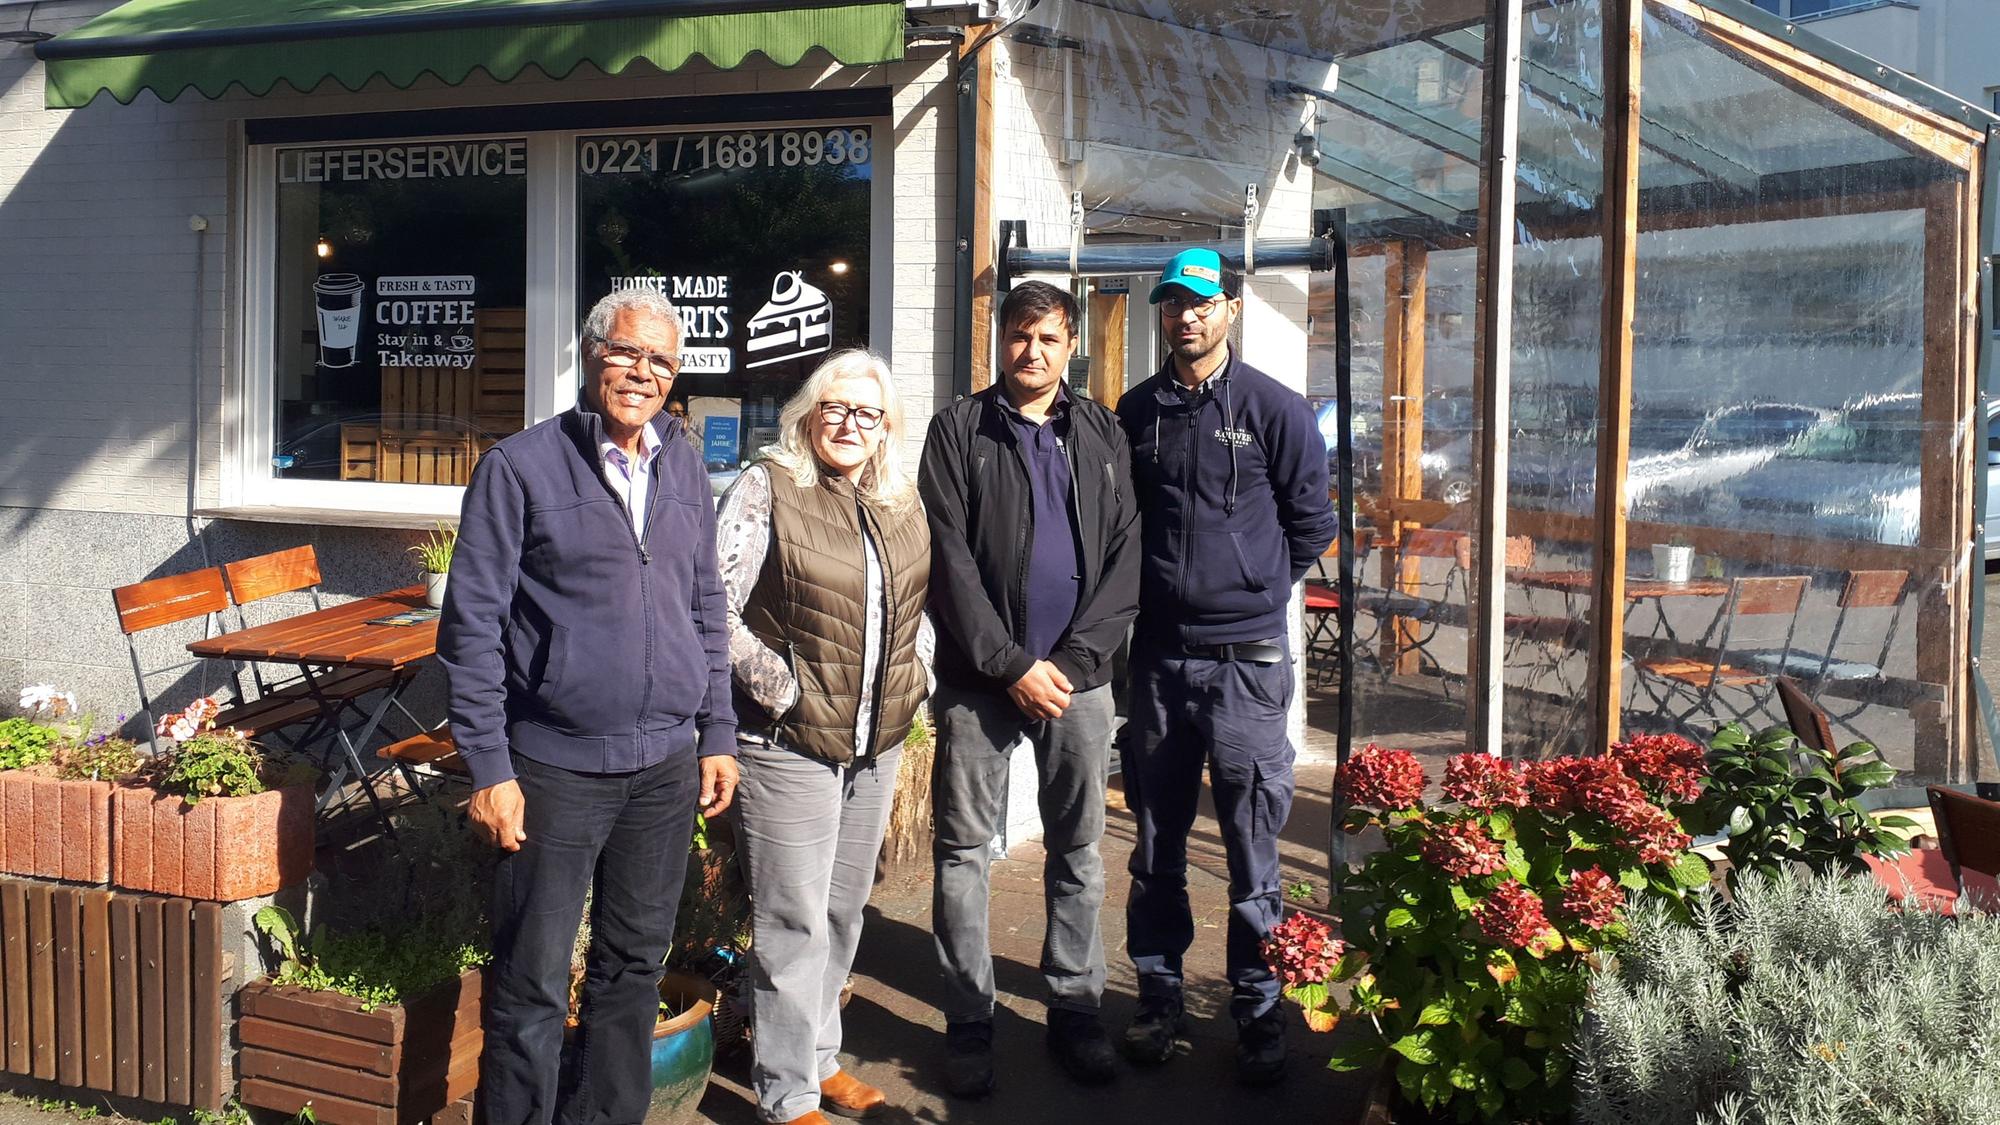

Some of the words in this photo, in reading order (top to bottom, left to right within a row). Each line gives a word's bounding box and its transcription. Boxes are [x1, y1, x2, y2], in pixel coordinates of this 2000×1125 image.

[279, 142, 526, 183] LIEFERSERVICE
[580, 138, 658, 175] 0221
[672, 136, 685, 171] /
[695, 128, 870, 169] 16818938
[379, 281, 418, 291] FRESH
[422, 281, 431, 291] &
[434, 280, 473, 291] TASTY
[610, 276, 667, 298] HOUSE
[672, 276, 728, 298] MADE
[376, 301, 475, 325] COFFEE
[673, 305, 729, 339] RTS
[377, 333, 407, 347] Stay
[413, 334, 428, 346] in
[434, 334, 443, 346] &
[378, 350, 475, 369] Takeaway
[681, 353, 728, 367] TASTY
